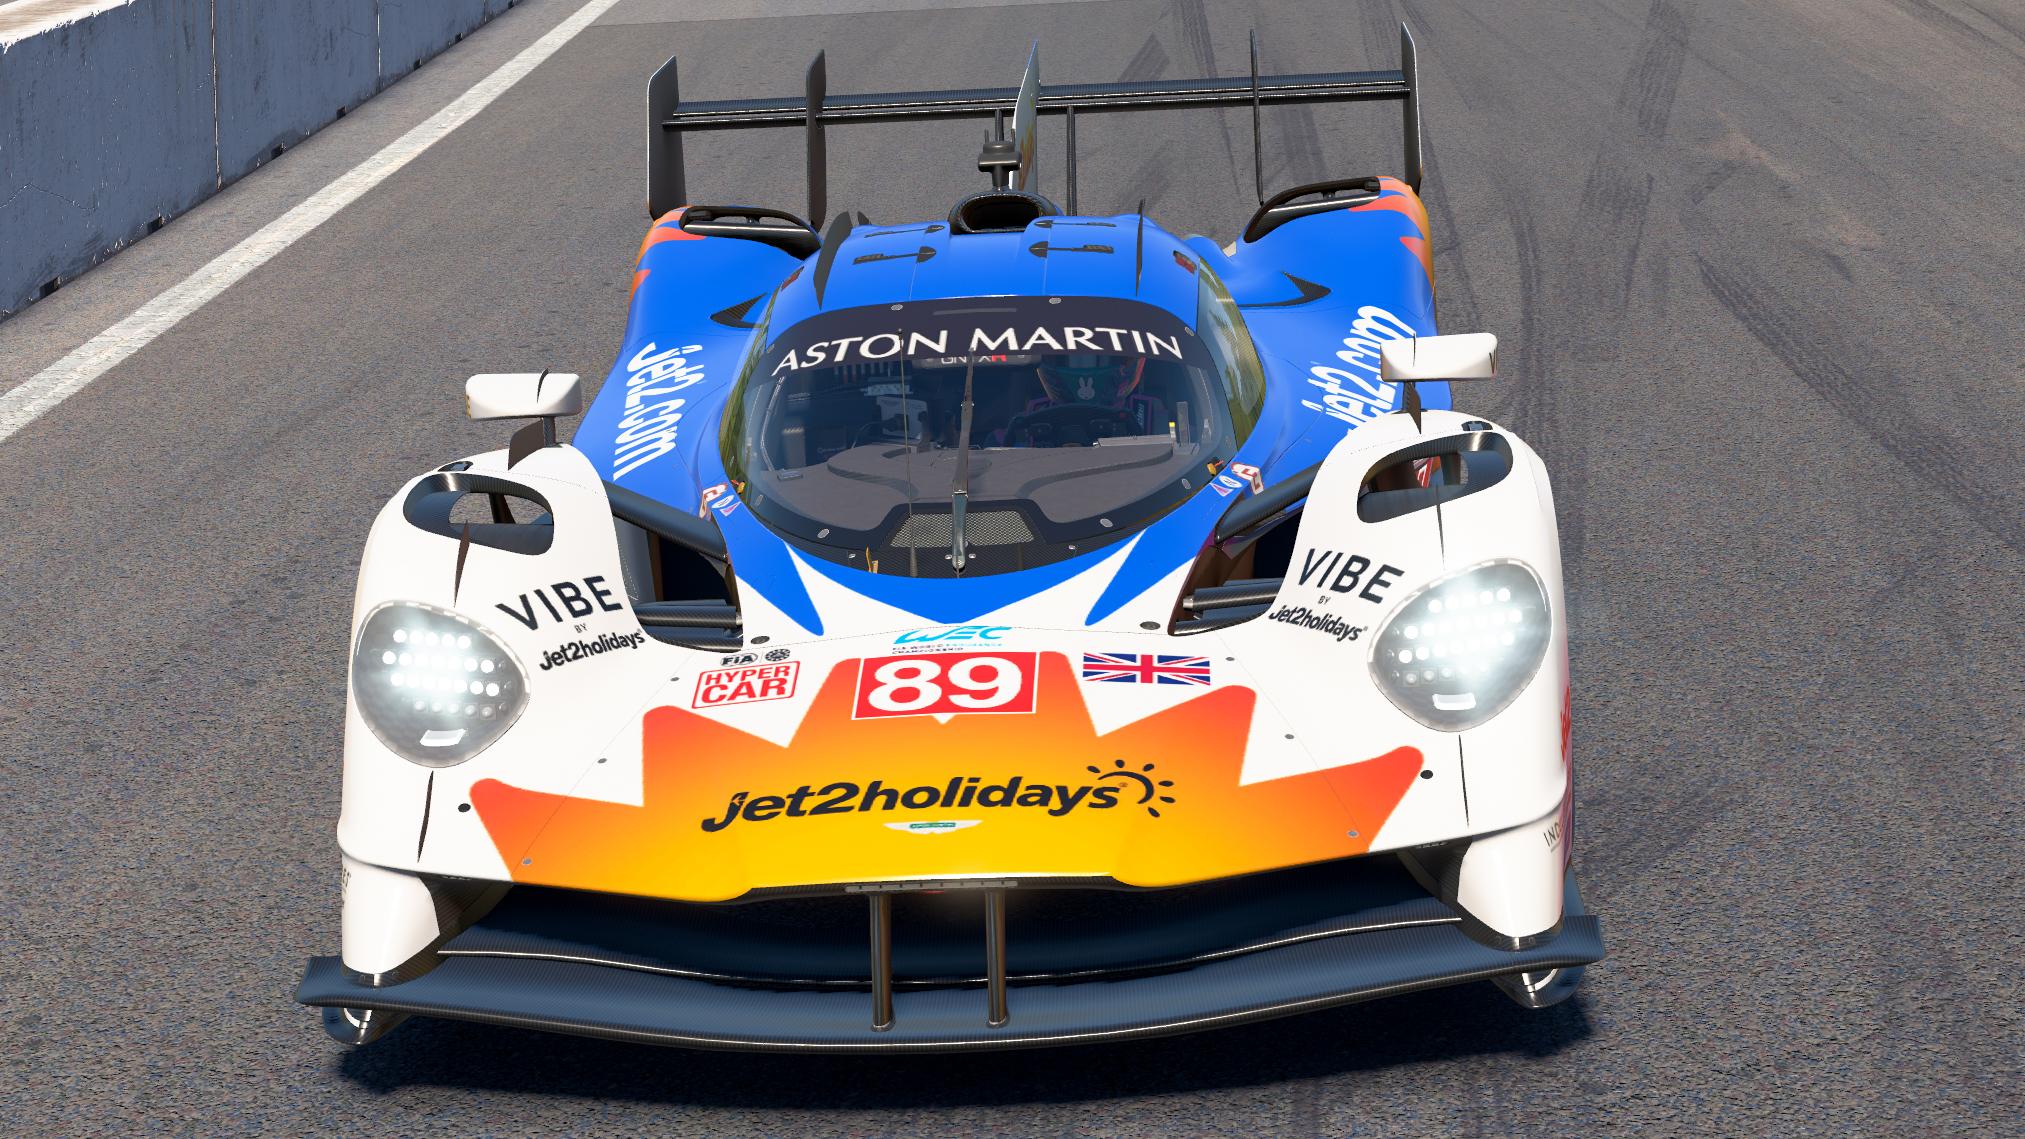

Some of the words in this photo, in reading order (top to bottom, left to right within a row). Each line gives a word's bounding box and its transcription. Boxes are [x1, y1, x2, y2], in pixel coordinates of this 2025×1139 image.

[770, 329, 948, 376] ASTON
[969, 326, 1183, 360] MARTIN
[1298, 548, 1405, 604] VIBE
[494, 575, 624, 631] VIBE
[1317, 595, 1331, 605] BY
[574, 623, 588, 634] BY
[893, 626, 1013, 645] WEC
[721, 654, 755, 666] FIA
[704, 665, 791, 686] HYPER
[867, 656, 1023, 712] 89
[701, 677, 788, 704] CAR
